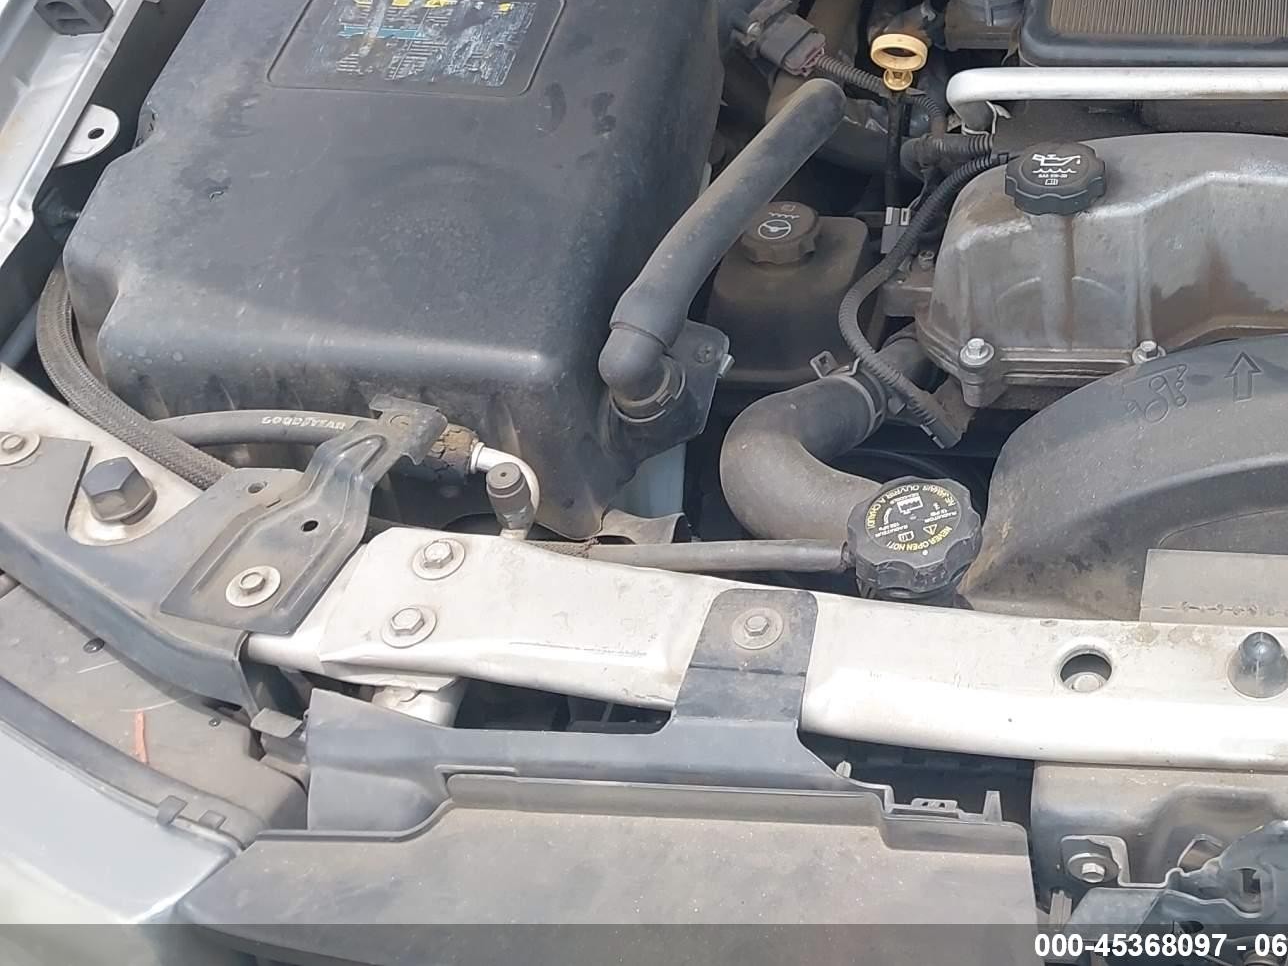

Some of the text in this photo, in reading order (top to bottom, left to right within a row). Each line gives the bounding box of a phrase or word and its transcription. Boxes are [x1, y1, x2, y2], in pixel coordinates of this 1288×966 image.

[261, 415, 346, 430] GOODYEAR
[928, 526, 953, 545] NEVER
[906, 540, 930, 551] OPEN
